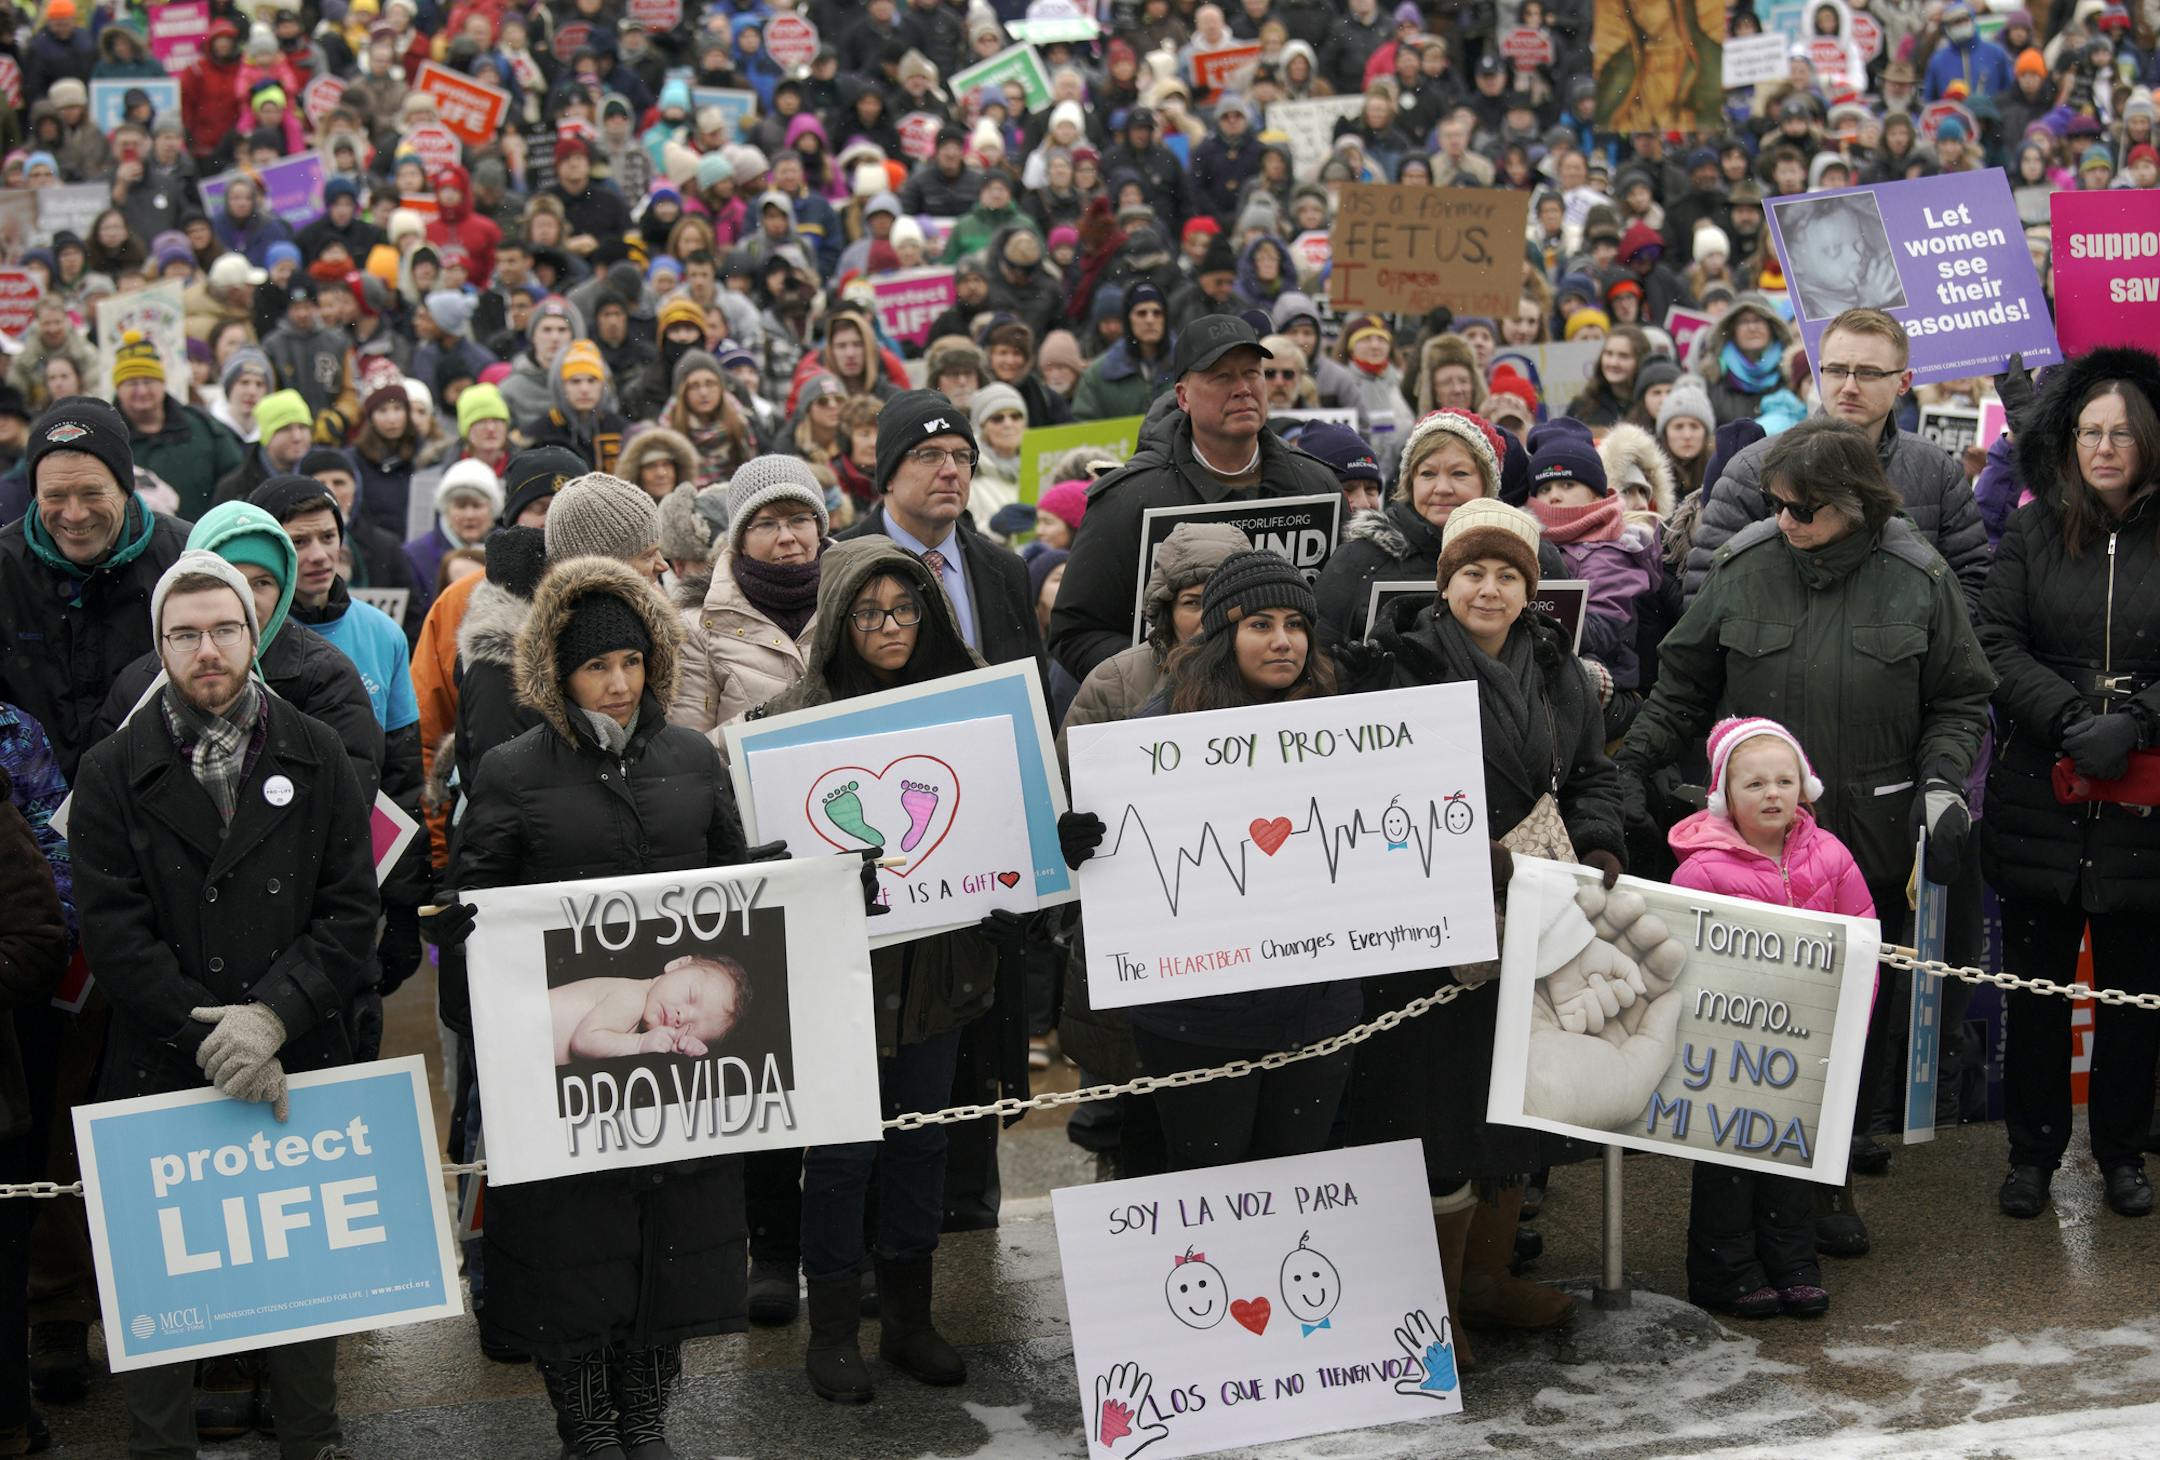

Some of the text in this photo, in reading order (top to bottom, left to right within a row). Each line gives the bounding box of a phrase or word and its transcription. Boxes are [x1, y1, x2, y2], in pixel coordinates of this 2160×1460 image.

[1923, 202, 1972, 230] Let
[1904, 227, 2006, 257] women
[2069, 231, 2160, 261] suppo
[1331, 262, 1366, 306] I
[1937, 256, 1988, 279] see
[1936, 276, 2002, 305] their
[1208, 319, 1240, 340] CAT
[1899, 297, 2030, 338] asounds!
[1943, 360, 1977, 370] CONCERNED
[1977, 358, 1988, 366] FOR
[1988, 356, 2000, 364] LIFE
[2005, 346, 2052, 361] w.mccl.org
[1534, 471, 1554, 481] MARCH
[1139, 721, 1414, 775] YO SOY PRO-VIDA
[908, 882, 930, 904] IS
[940, 878, 953, 900] A
[962, 870, 998, 896] GIFT
[560, 877, 767, 955] YO SOY
[1106, 915, 1451, 983] The HEARTBEAT Changes Everything!
[1689, 906, 1835, 972] Toma mi
[1694, 987, 1810, 1038] mano...
[1729, 1039, 1798, 1088] NO
[562, 1053, 794, 1156] PRO VIDA
[1646, 1091, 1810, 1160] MI VIDA
[150, 1115, 372, 1199] protect
[158, 1175, 387, 1277] LIFE
[1108, 1181, 1359, 1235] SOY LA VOZ PARA
[159, 1307, 204, 1331] MCCL
[213, 1280, 431, 1321] MINNESOTA CITIZENS CONCERNED FOR LIFE www.mccl.org
[1146, 1354, 1422, 1424] LOS QUE NO TIENEN VOZ
